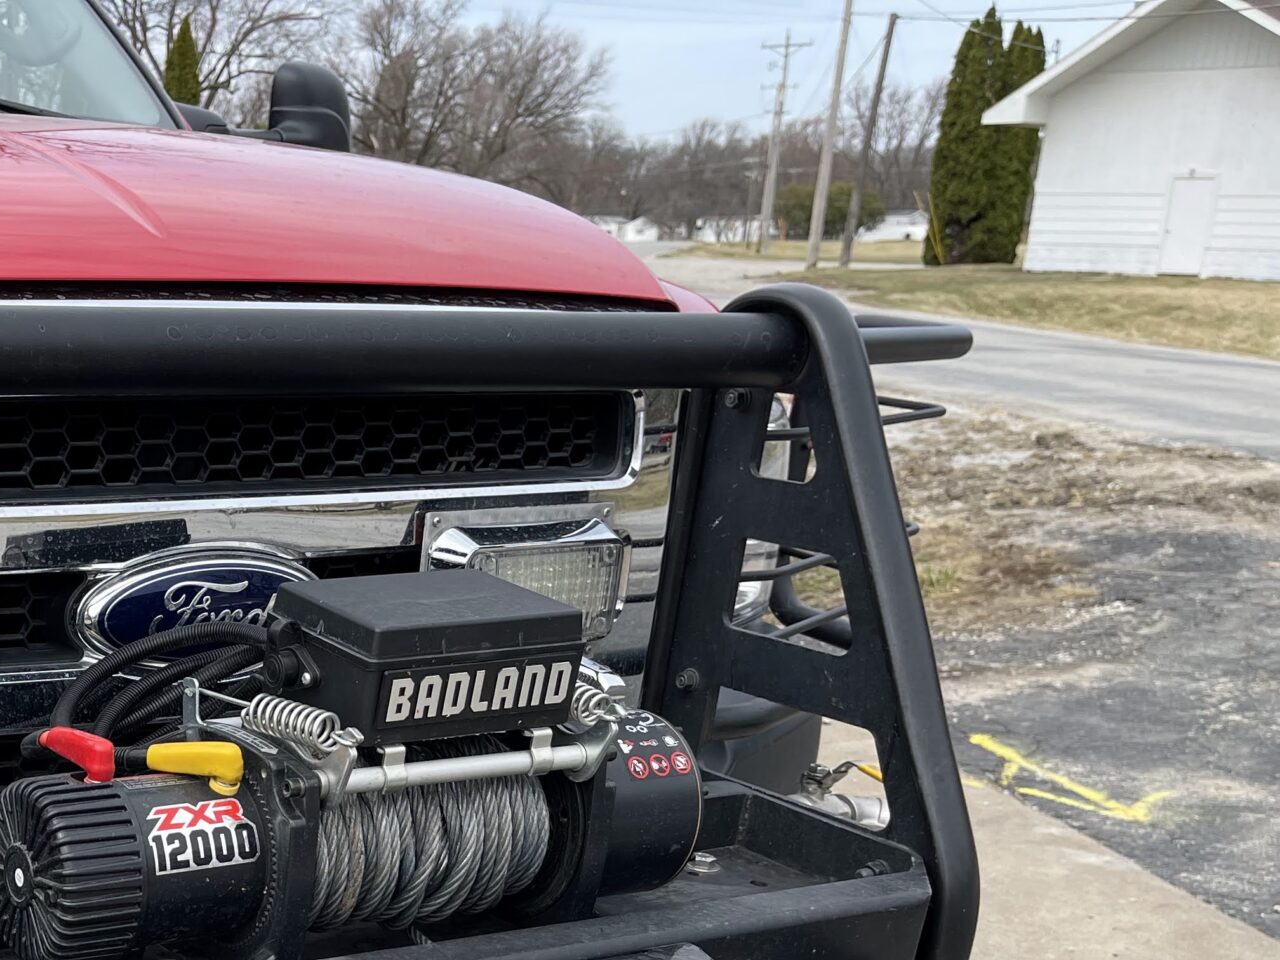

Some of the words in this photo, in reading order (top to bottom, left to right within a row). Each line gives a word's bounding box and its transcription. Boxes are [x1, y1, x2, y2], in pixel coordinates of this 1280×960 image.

[385, 661, 572, 723] BADLAND
[153, 799, 245, 832] ZXR
[151, 822, 259, 873] 12000
